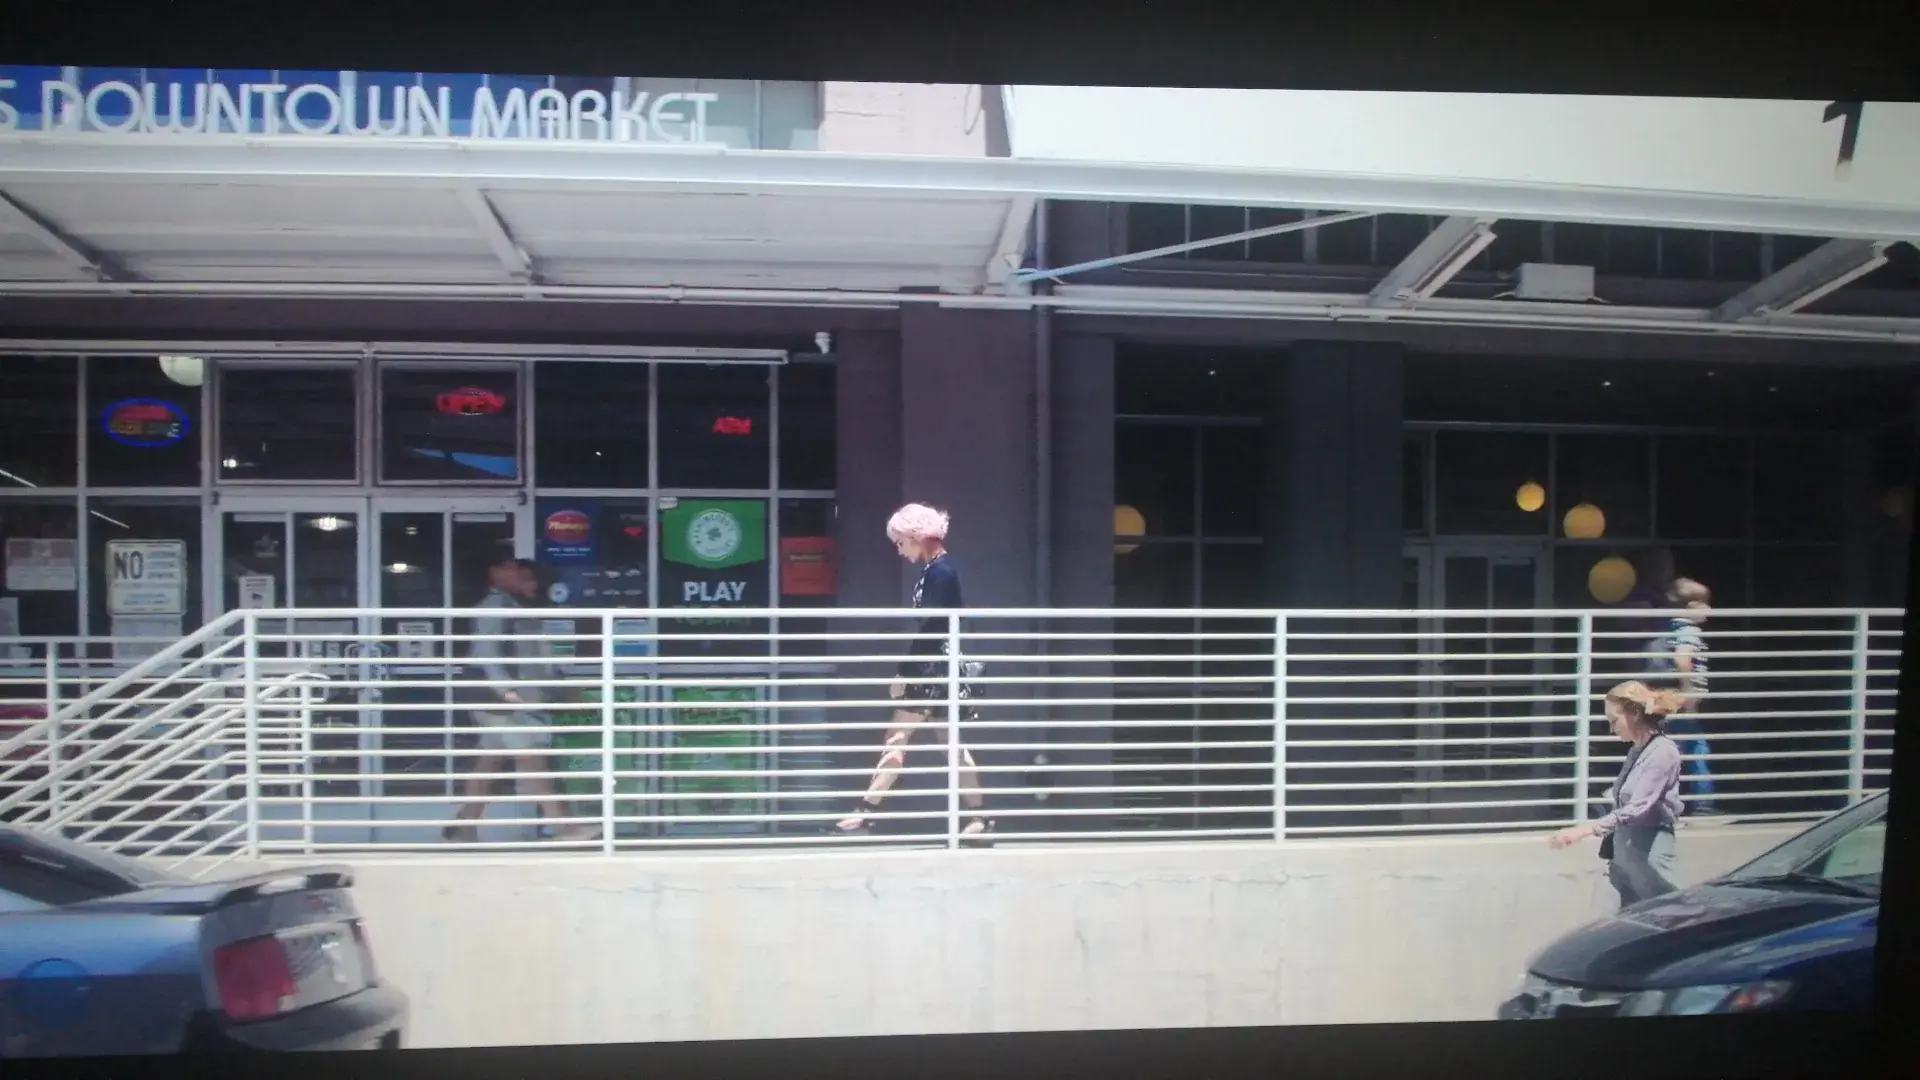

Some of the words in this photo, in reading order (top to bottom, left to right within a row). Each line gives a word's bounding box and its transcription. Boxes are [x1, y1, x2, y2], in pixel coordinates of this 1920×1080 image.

[42, 80, 451, 137] DOWNTOWN
[470, 87, 719, 143] MARKET
[114, 550, 143, 579] NO
[683, 581, 747, 601] PLAY
